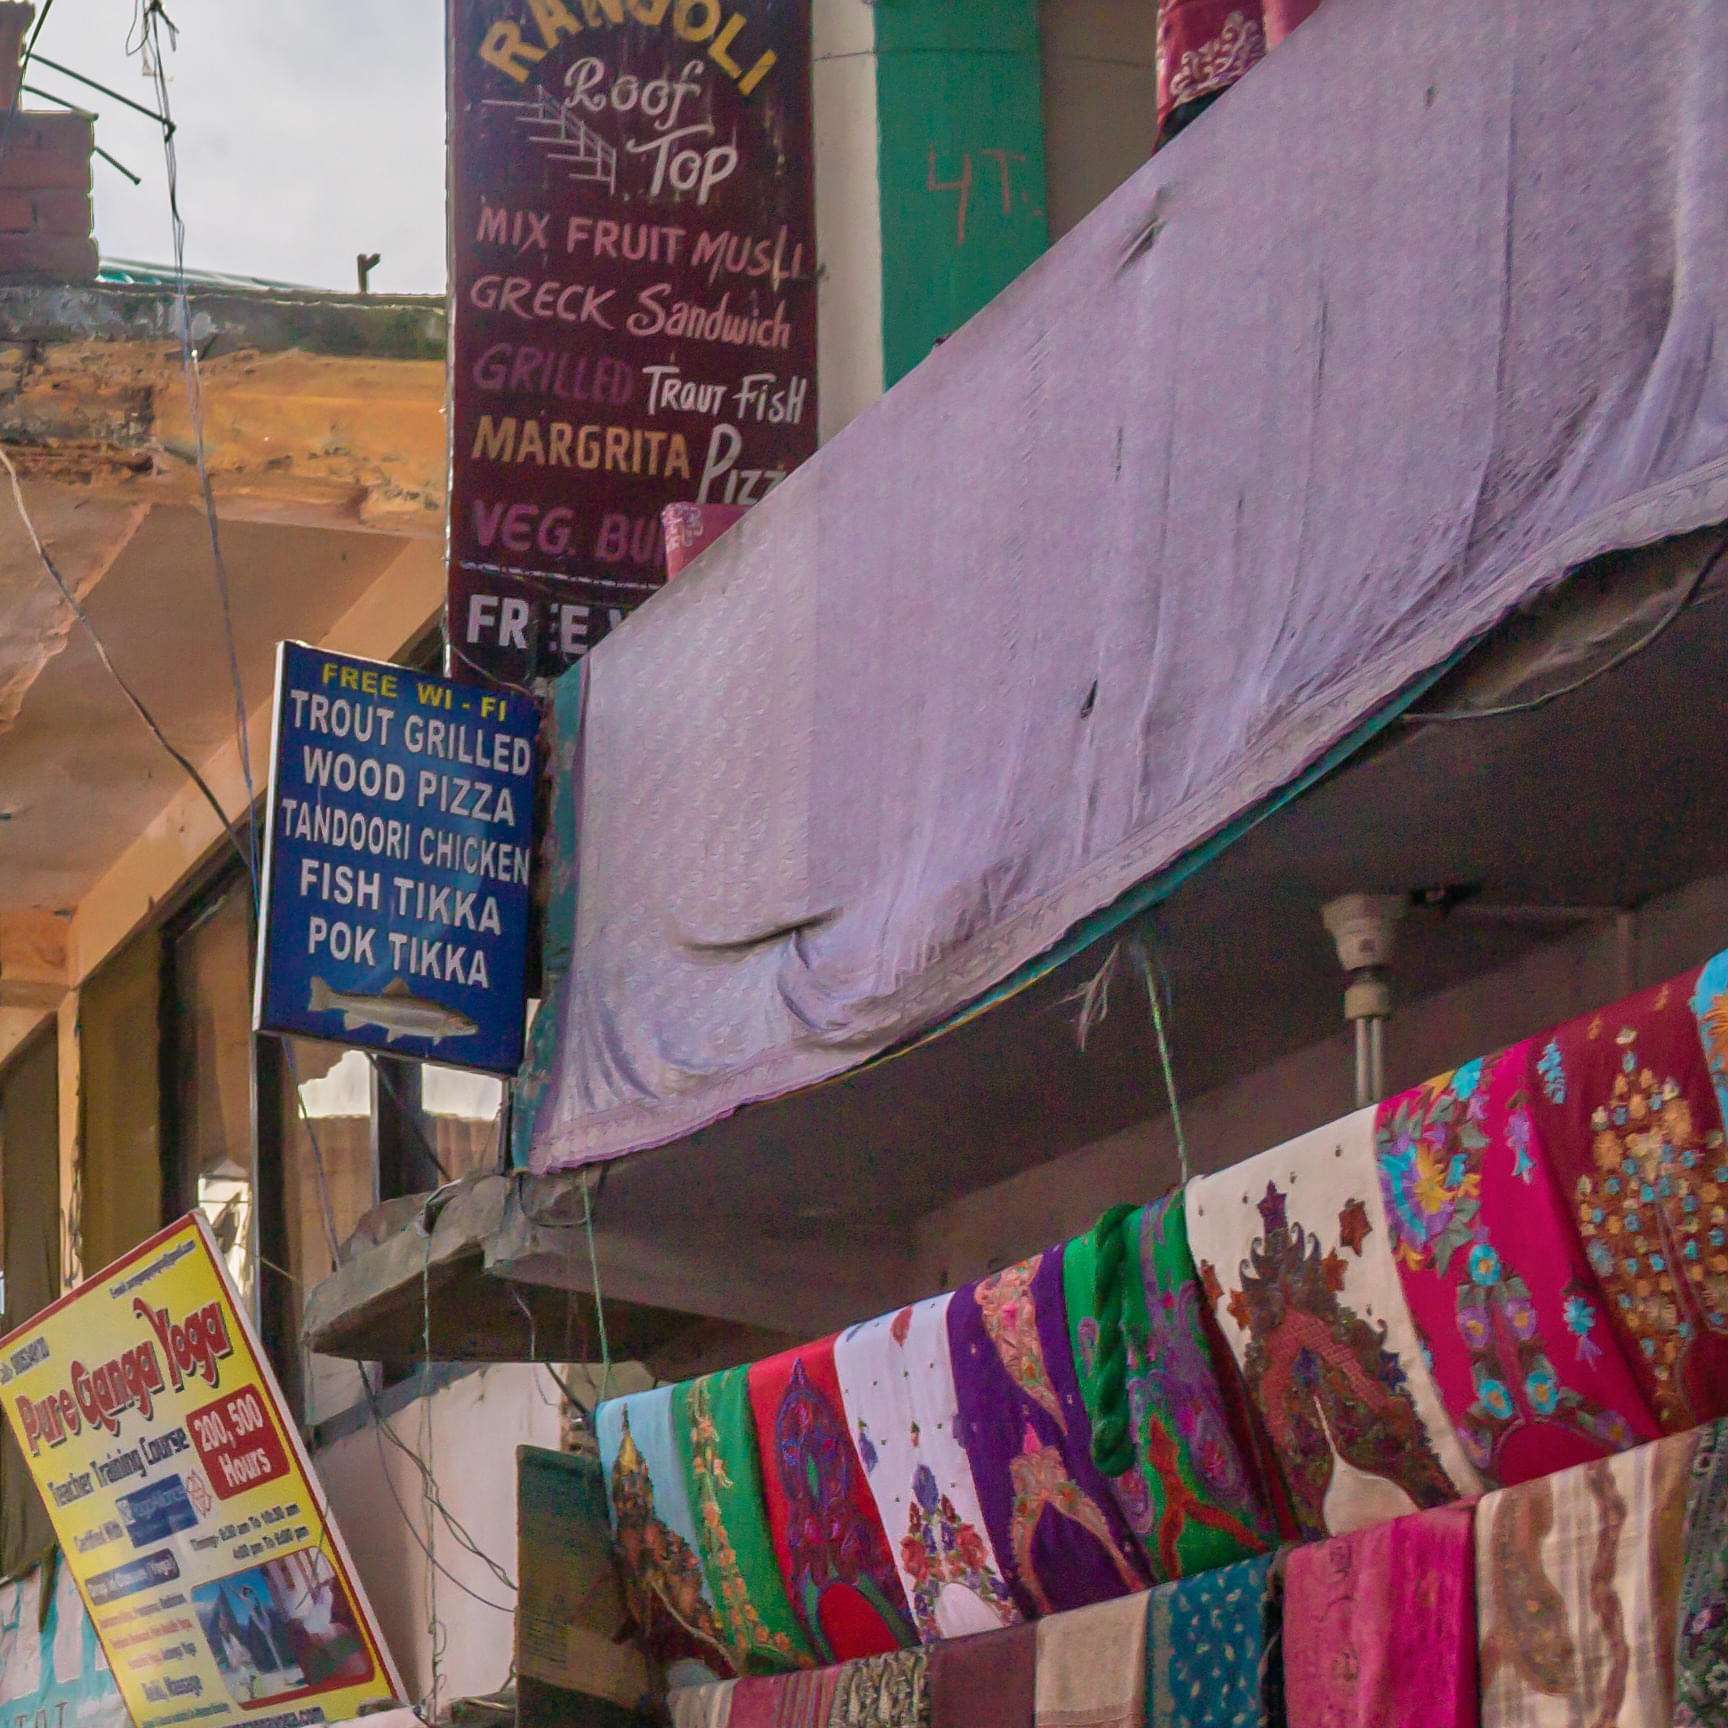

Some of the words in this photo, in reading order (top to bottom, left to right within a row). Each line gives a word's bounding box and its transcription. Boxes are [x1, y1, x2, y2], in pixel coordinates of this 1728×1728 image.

[477, 205, 549, 256] MIX
[567, 215, 686, 265] FRUIT
[470, 275, 615, 331] GRECK
[471, 415, 690, 480] MARGRITA
[466, 594, 590, 655] FRE
[321, 663, 398, 699] FREE
[290, 689, 394, 746] TROUT
[404, 714, 531, 777] GRILLED
[303, 745, 405, 802] WOOD
[418, 770, 515, 827] PIZZA
[282, 798, 411, 860] TANDOORI
[419, 826, 531, 886] CHICKEN
[300, 858, 381, 911] FISH
[393, 876, 502, 936] TIKKA
[308, 916, 377, 968] POK
[388, 932, 489, 989] TIKKA
[14, 1388, 82, 1457] Pure
[133, 1297, 233, 1393] Yoga
[218, 1447, 272, 1488] Hours
